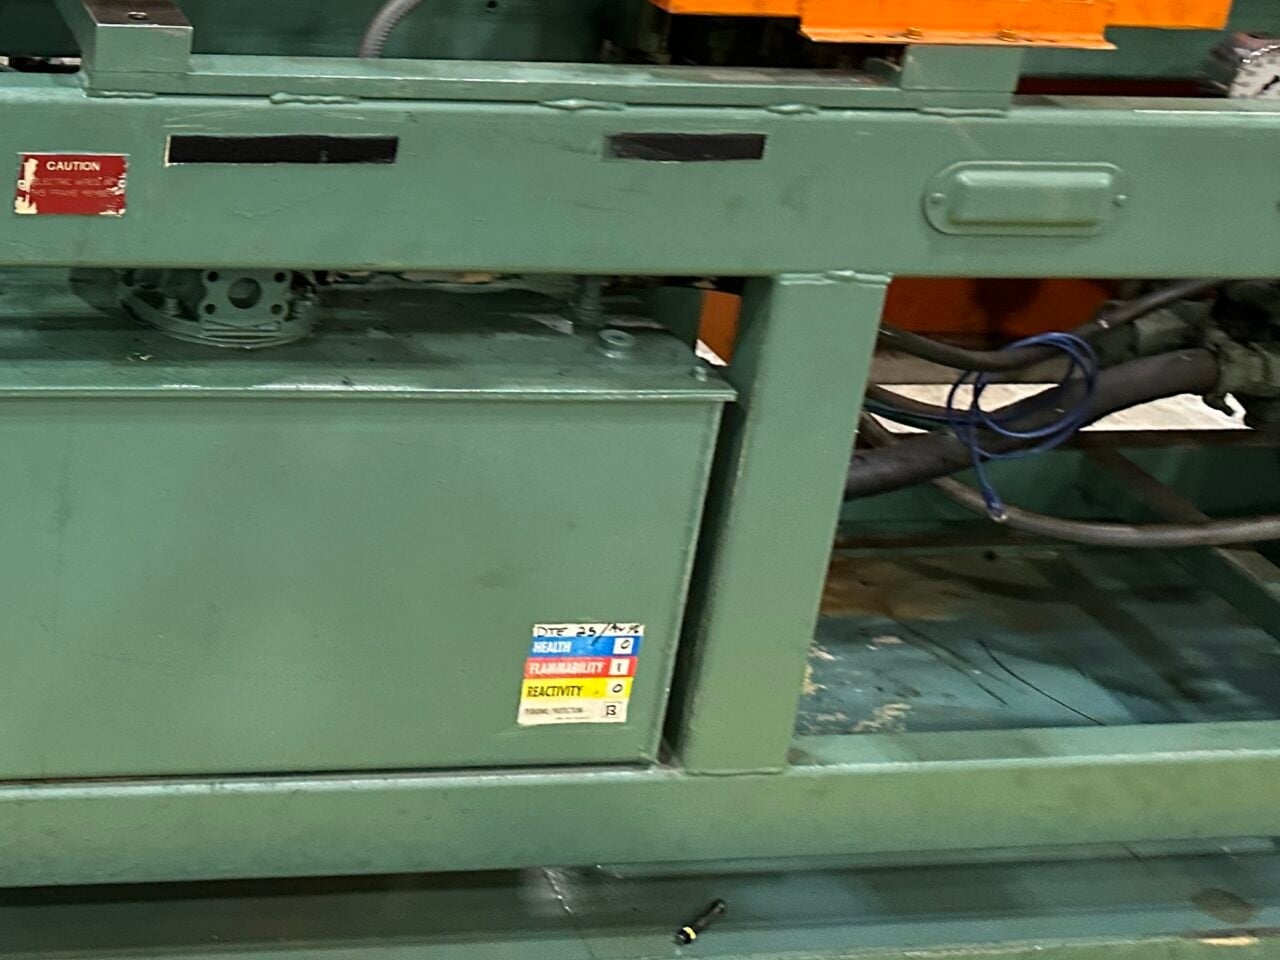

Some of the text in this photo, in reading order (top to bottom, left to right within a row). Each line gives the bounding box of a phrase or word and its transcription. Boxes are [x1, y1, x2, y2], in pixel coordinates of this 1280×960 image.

[45, 161, 101, 171] CAUTION
[532, 641, 572, 653] HEALTH
[528, 661, 606, 675] FLAMMABILITY
[526, 685, 584, 698] REACTIVITY
